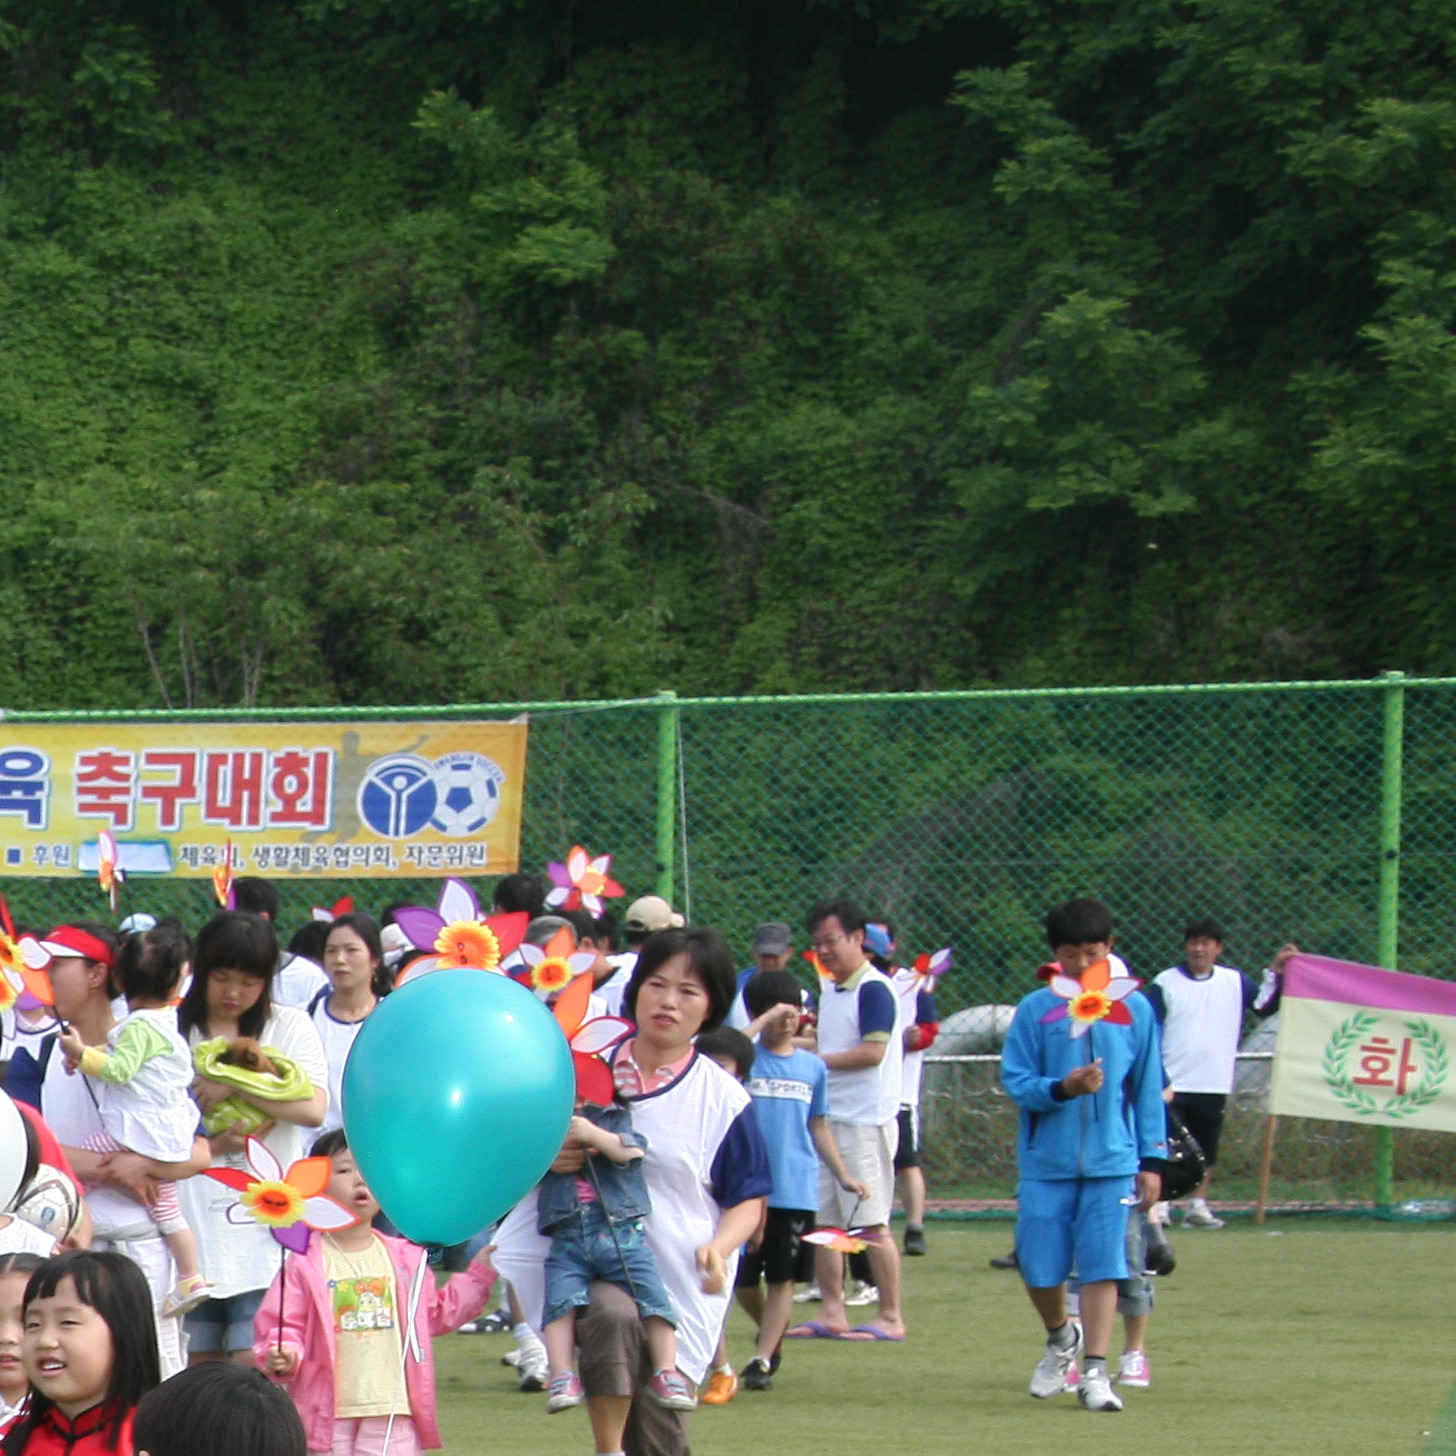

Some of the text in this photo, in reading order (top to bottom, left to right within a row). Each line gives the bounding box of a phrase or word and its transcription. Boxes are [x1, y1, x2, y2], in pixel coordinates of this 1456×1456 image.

[76, 749, 331, 828] 축구대회
[405, 843, 486, 867] 자문위원
[1352, 1036, 1419, 1096] 화
